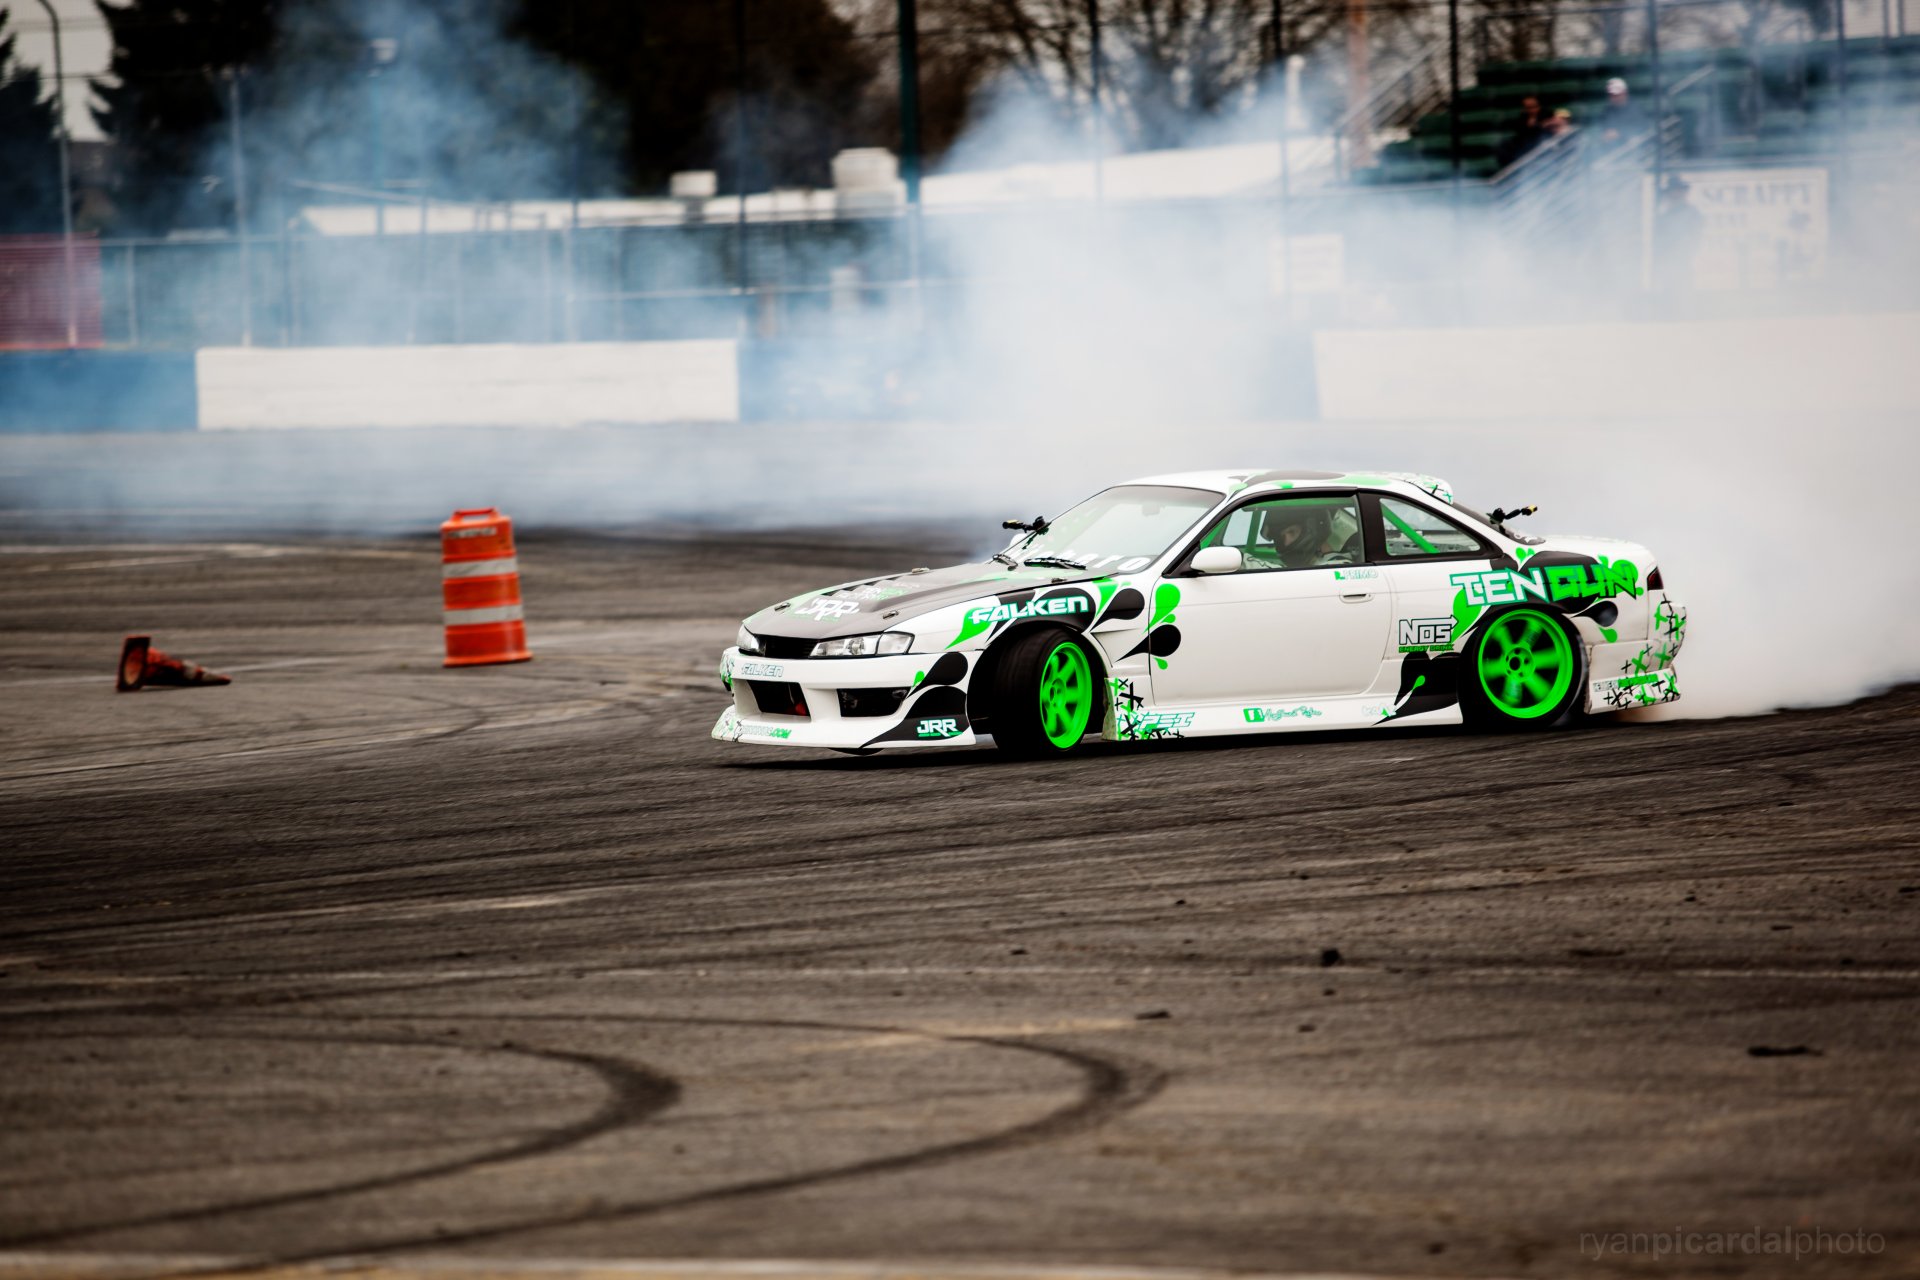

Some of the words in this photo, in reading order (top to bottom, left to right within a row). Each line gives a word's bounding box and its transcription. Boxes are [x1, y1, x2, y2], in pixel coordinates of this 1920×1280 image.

[969, 595, 1089, 625] FALKEN
[1399, 615, 1458, 645] NOS
[741, 663, 784, 677] FALKEN
[916, 718, 961, 737] JRR
